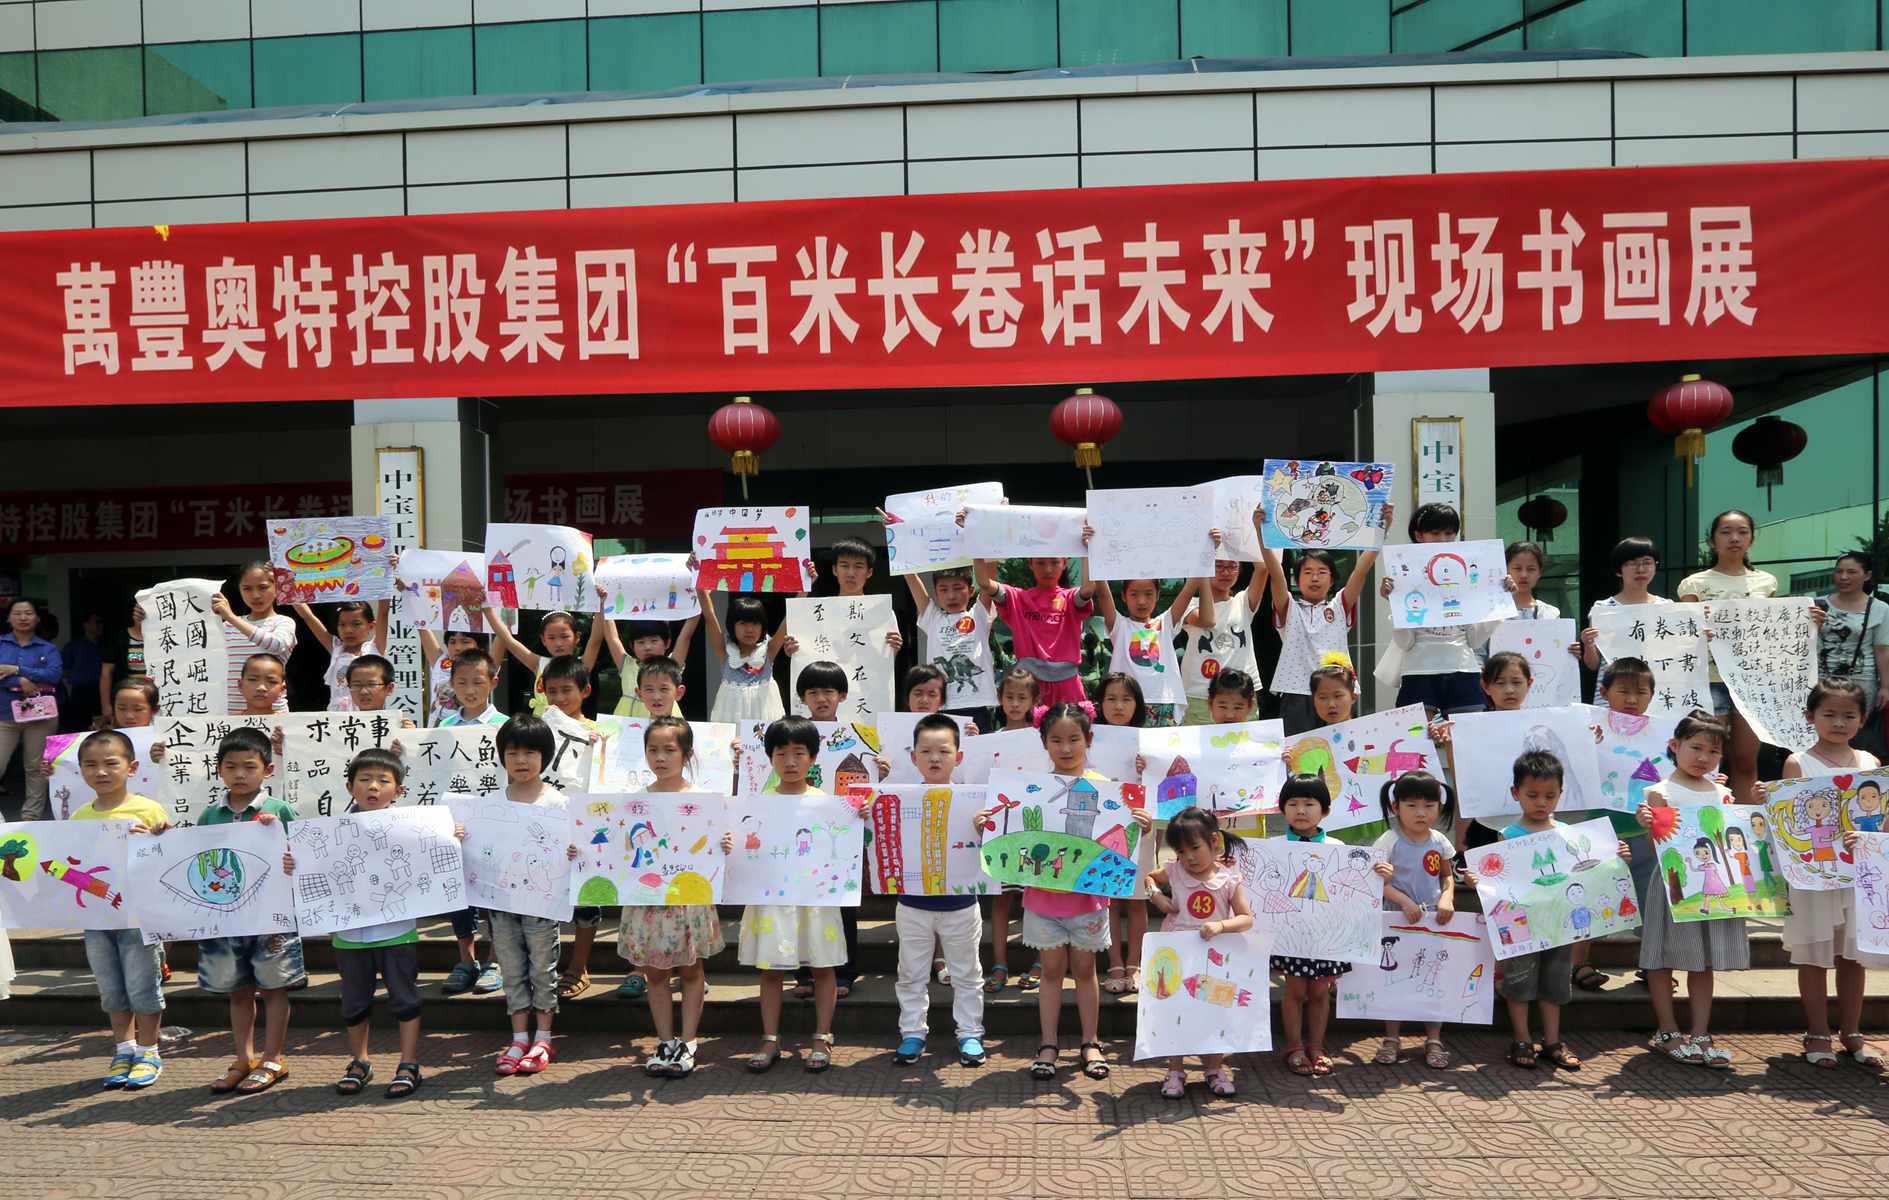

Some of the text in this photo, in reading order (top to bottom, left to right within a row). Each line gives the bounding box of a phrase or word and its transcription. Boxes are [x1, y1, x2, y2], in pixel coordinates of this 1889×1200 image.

[1422, 440, 1456, 503] 中宝
[959, 617, 972, 630] 27
[1204, 661, 1217, 675] 14
[1427, 854, 1441, 871] 38
[1192, 895, 1212, 913] 43
